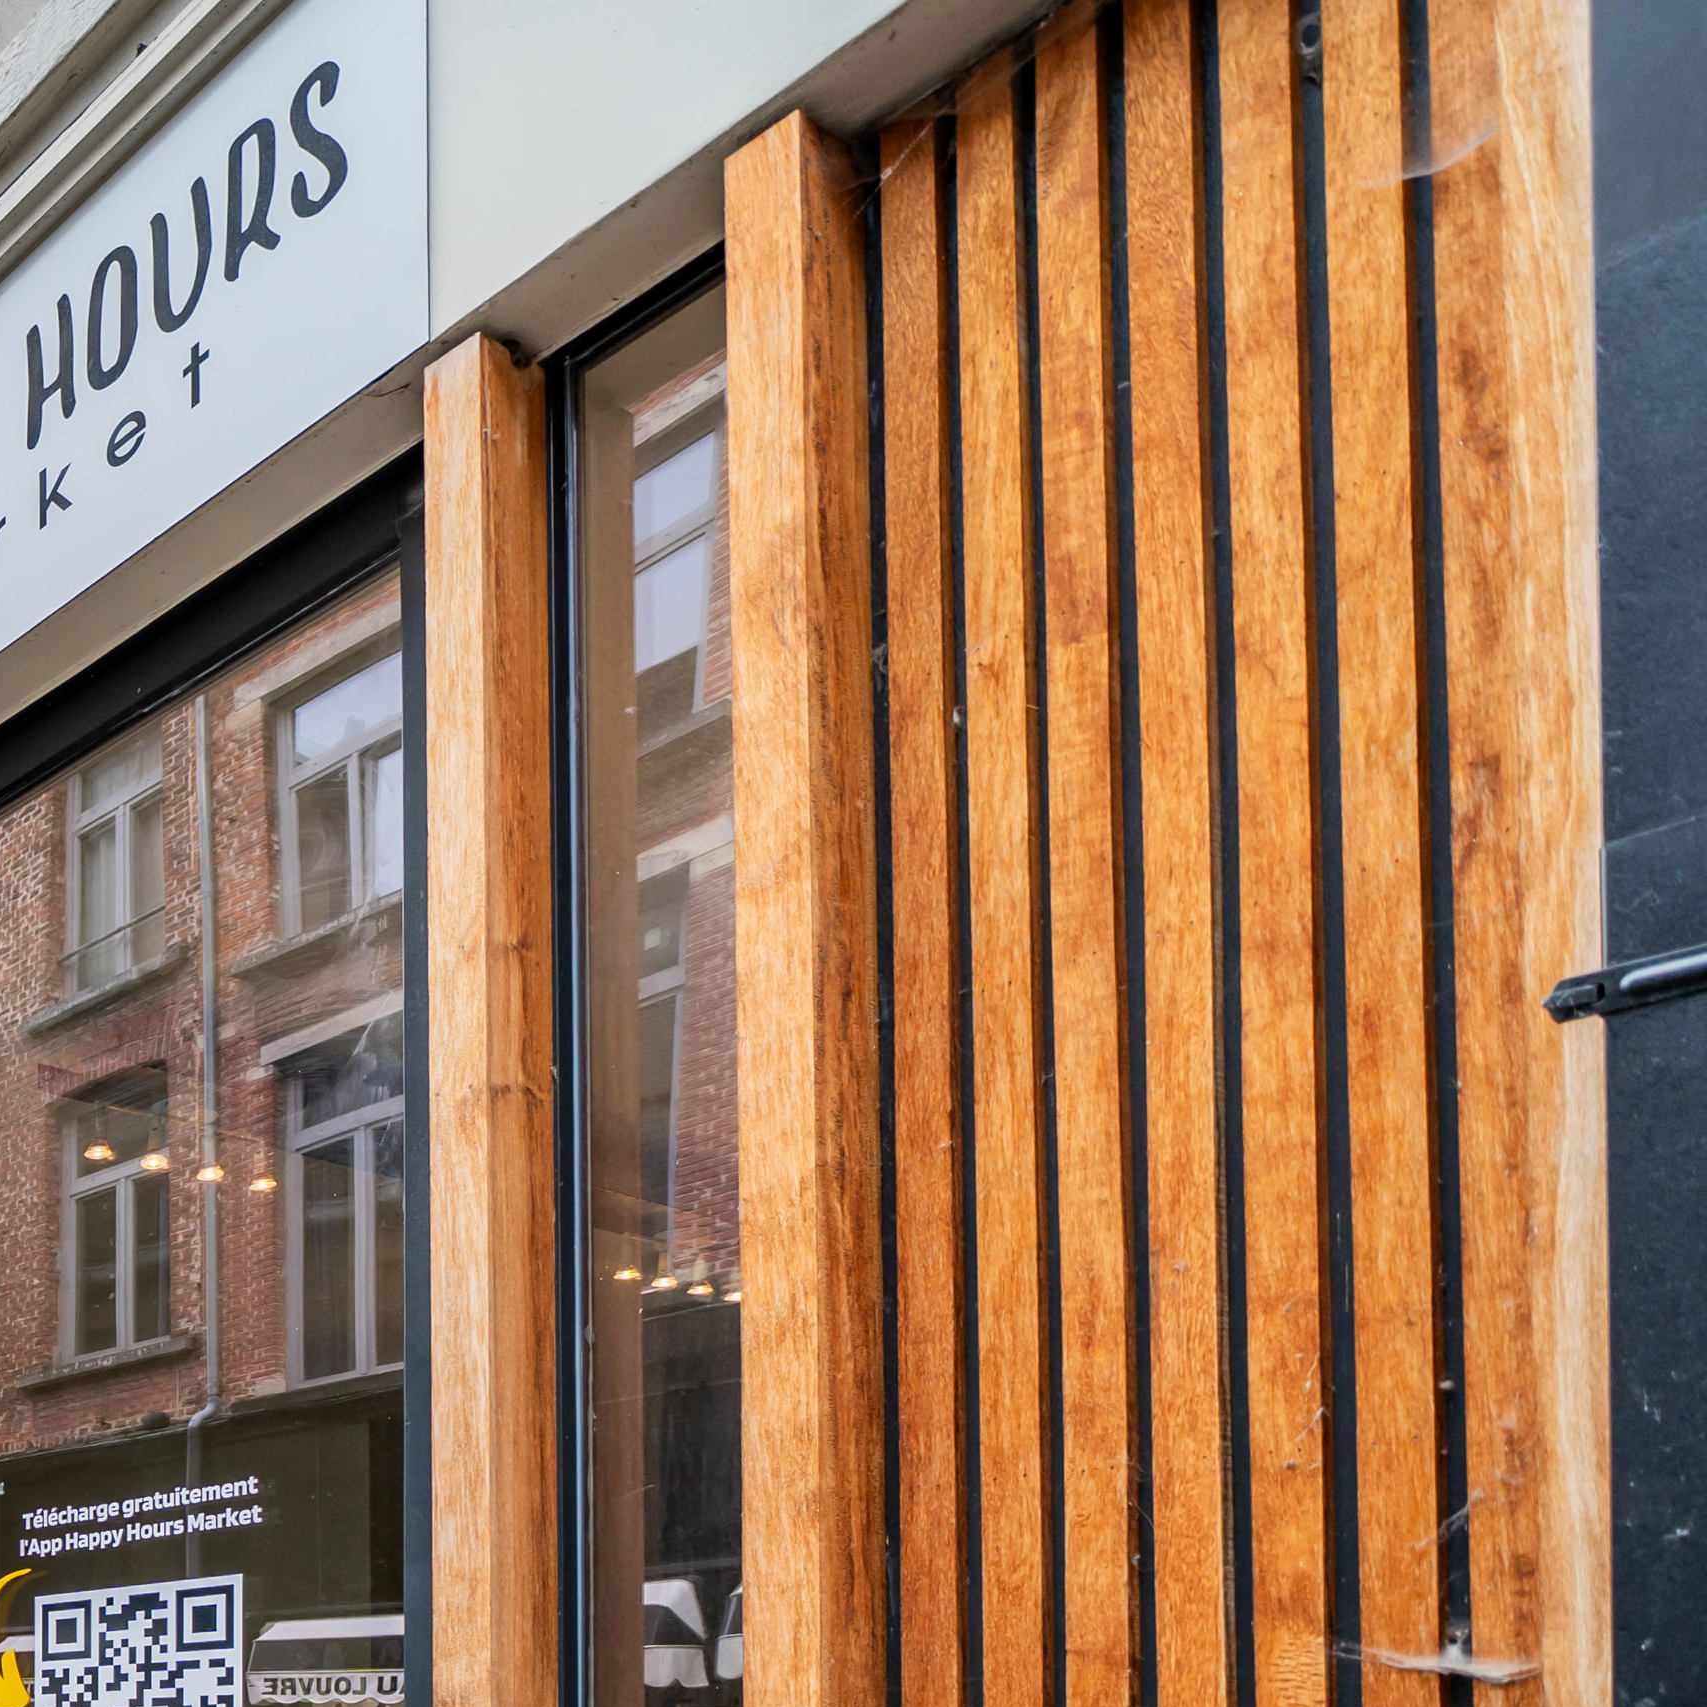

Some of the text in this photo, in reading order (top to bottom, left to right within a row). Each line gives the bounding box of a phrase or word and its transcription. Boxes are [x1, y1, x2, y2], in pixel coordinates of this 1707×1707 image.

[25, 59, 349, 450] HOURS
[22, 1475, 259, 1530] Télécharge gratuitement
[19, 1505, 263, 1558] l'App Happy Hours Market
